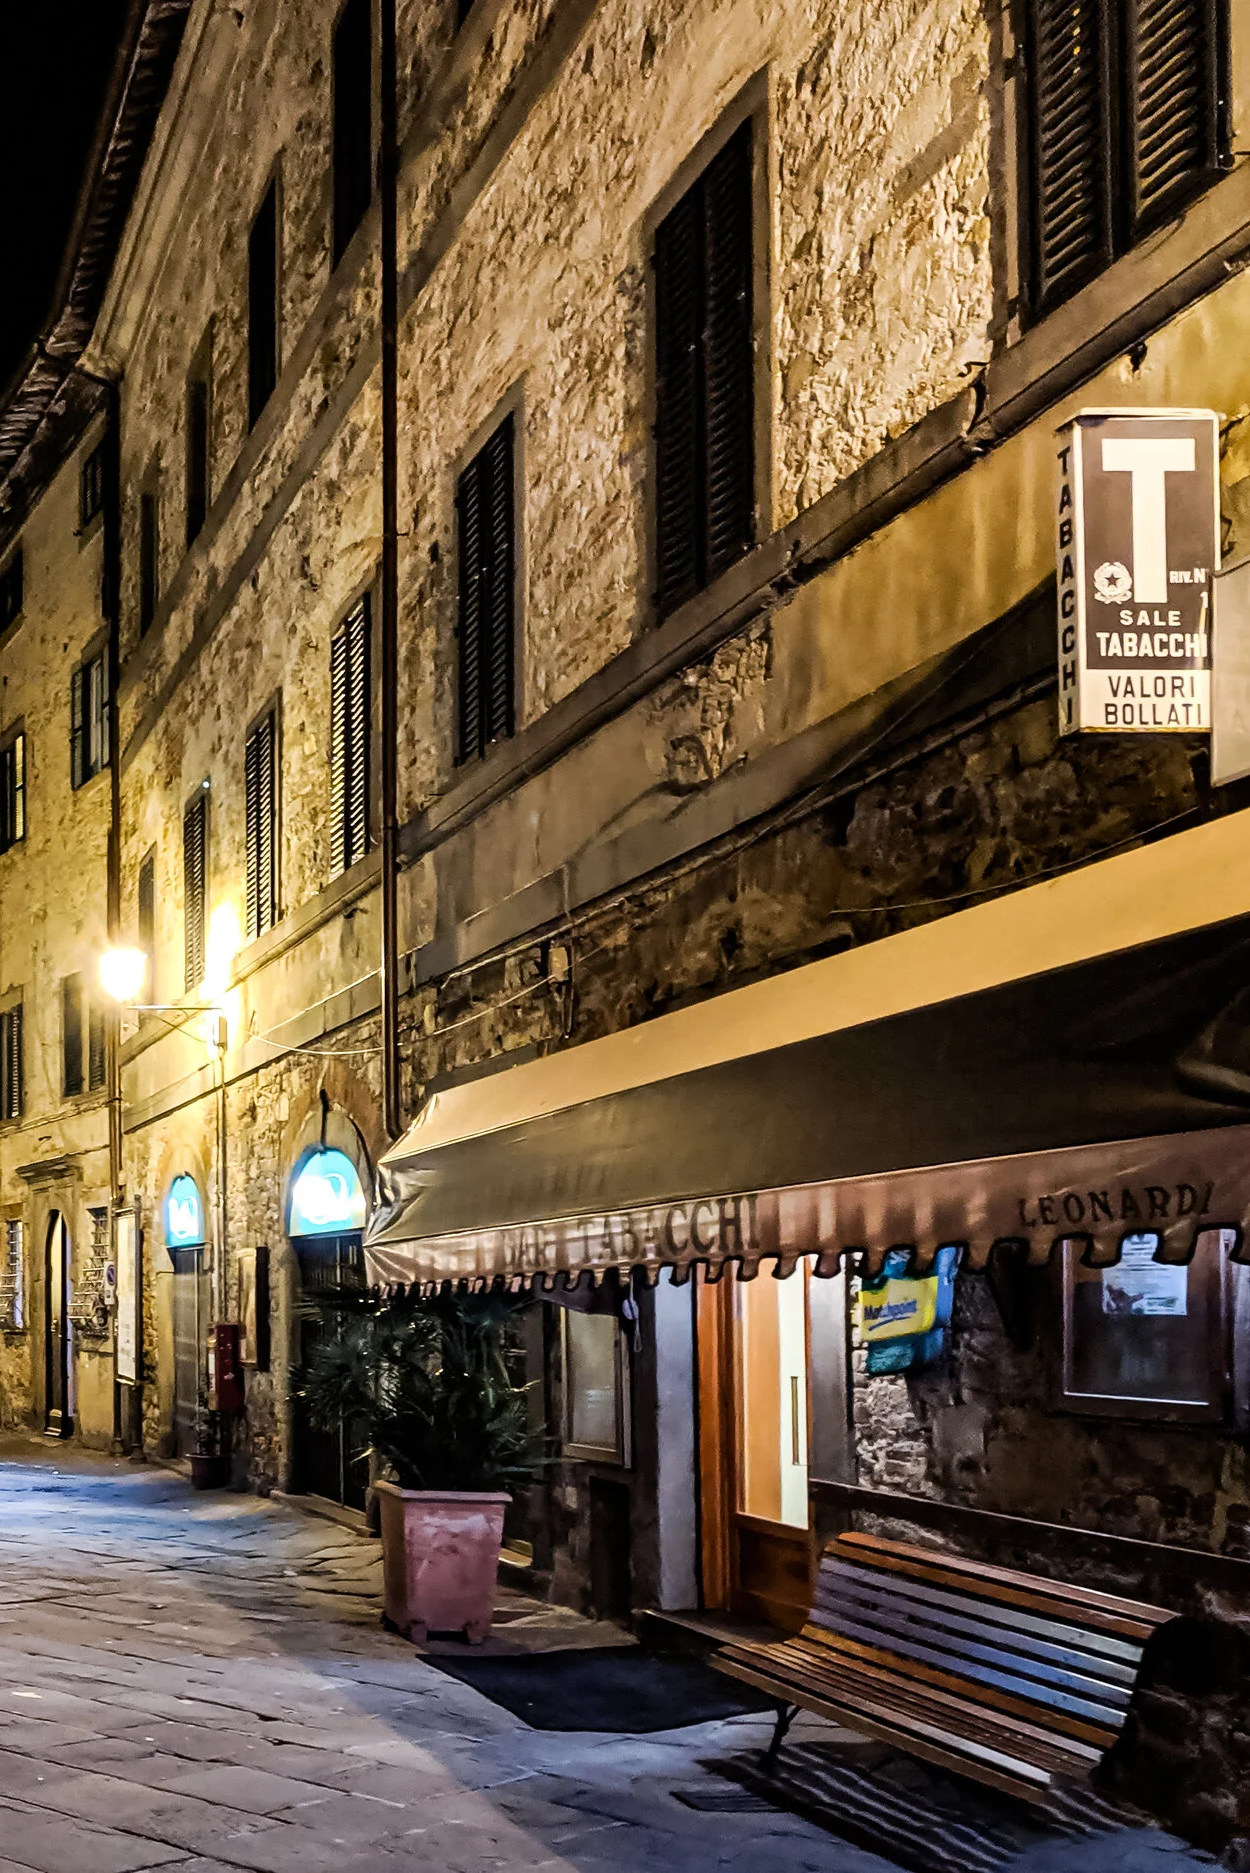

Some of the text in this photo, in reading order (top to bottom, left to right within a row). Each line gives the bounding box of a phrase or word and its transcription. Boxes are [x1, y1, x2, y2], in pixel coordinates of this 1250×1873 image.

[1101, 438, 1196, 604] T
[1057, 446, 1077, 724] TABACCHI
[1119, 609, 1182, 626] SALE
[1095, 632, 1208, 657] TABACCHI
[1108, 675, 1195, 698] VALORI
[1104, 703, 1202, 725] BOLLATI
[1016, 1181, 1216, 1228] LEONARDI
